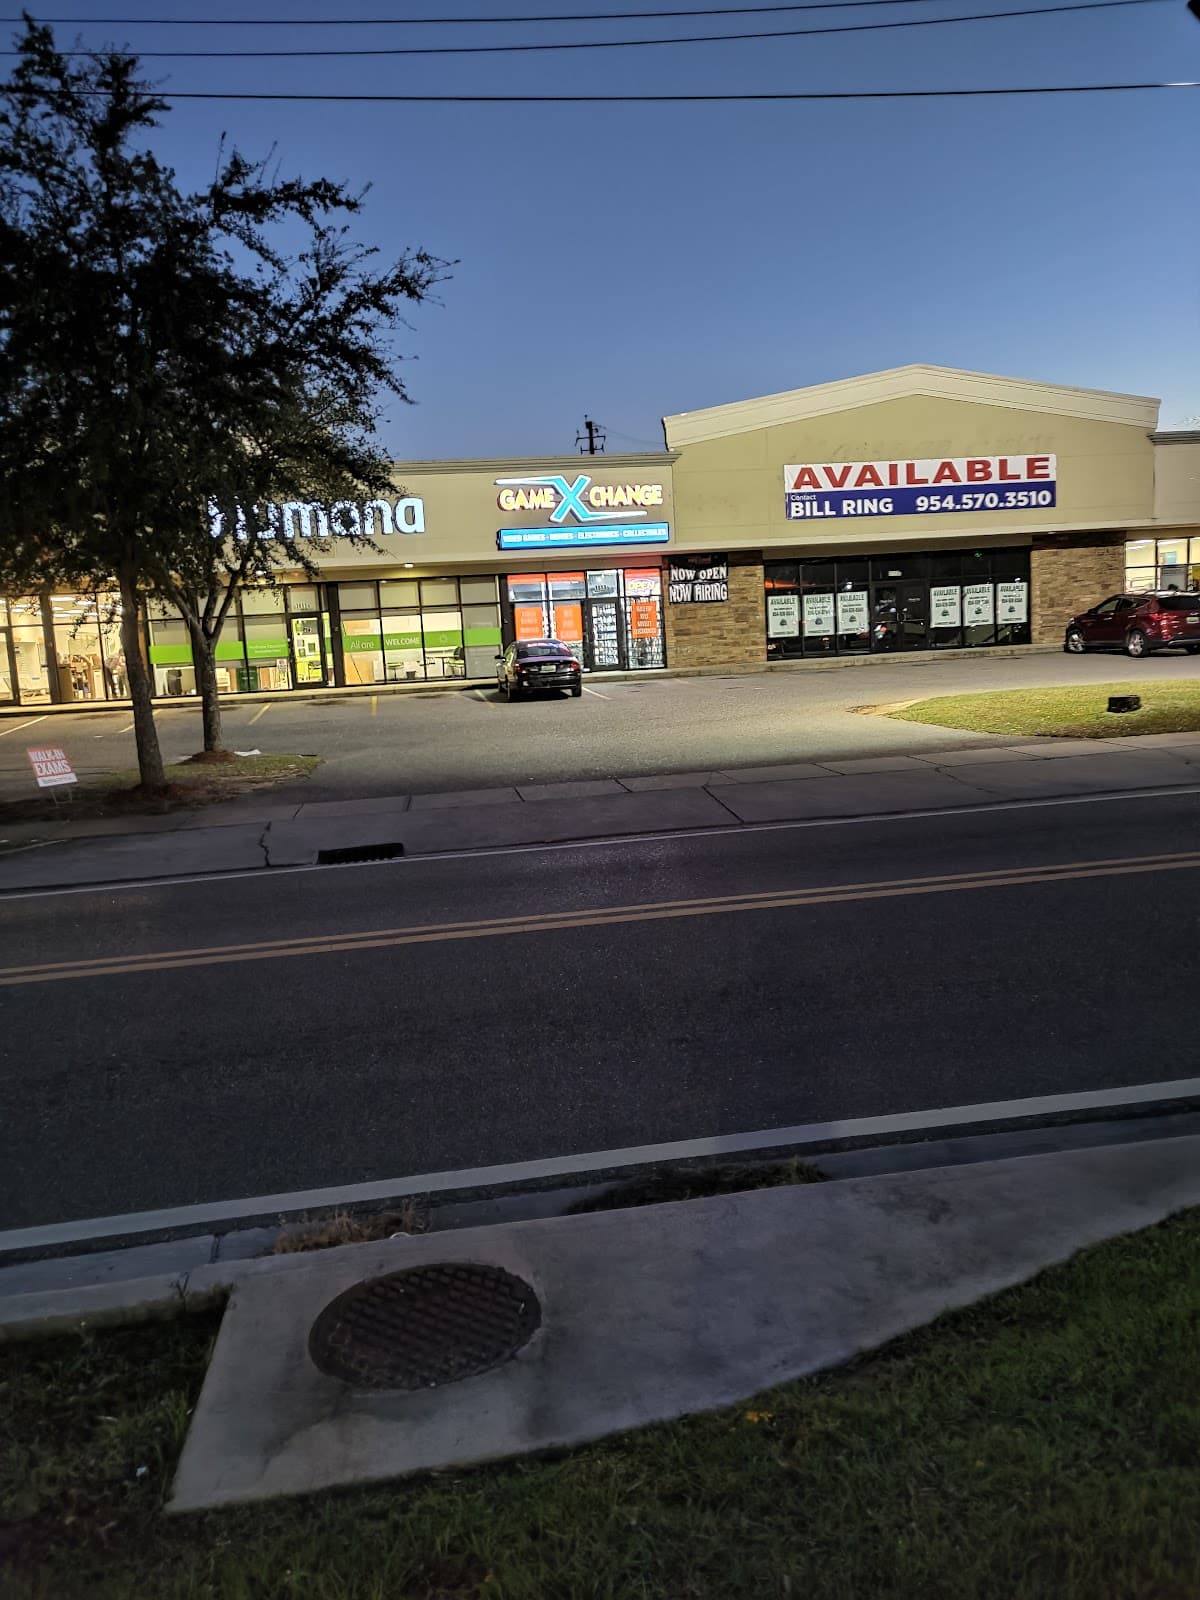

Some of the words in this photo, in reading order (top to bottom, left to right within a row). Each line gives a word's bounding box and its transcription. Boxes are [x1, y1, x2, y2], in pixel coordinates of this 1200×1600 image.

[791, 456, 1051, 490] AVAILABLE
[498, 487, 556, 511] GAME
[549, 474, 592, 523] X
[588, 484, 664, 507] CHANGE
[790, 493, 817, 502] Contact
[790, 500, 836, 518] BILL
[842, 498, 894, 515] RING
[915, 489, 1052, 512] 954.570.3510
[670, 567, 696, 581] NOW
[699, 566, 728, 580] OPEN
[669, 583, 692, 603] NOW
[694, 583, 728, 601] HIRING
[385, 637, 420, 647] WELCOME
[33, 760, 72, 777] EXAMS
